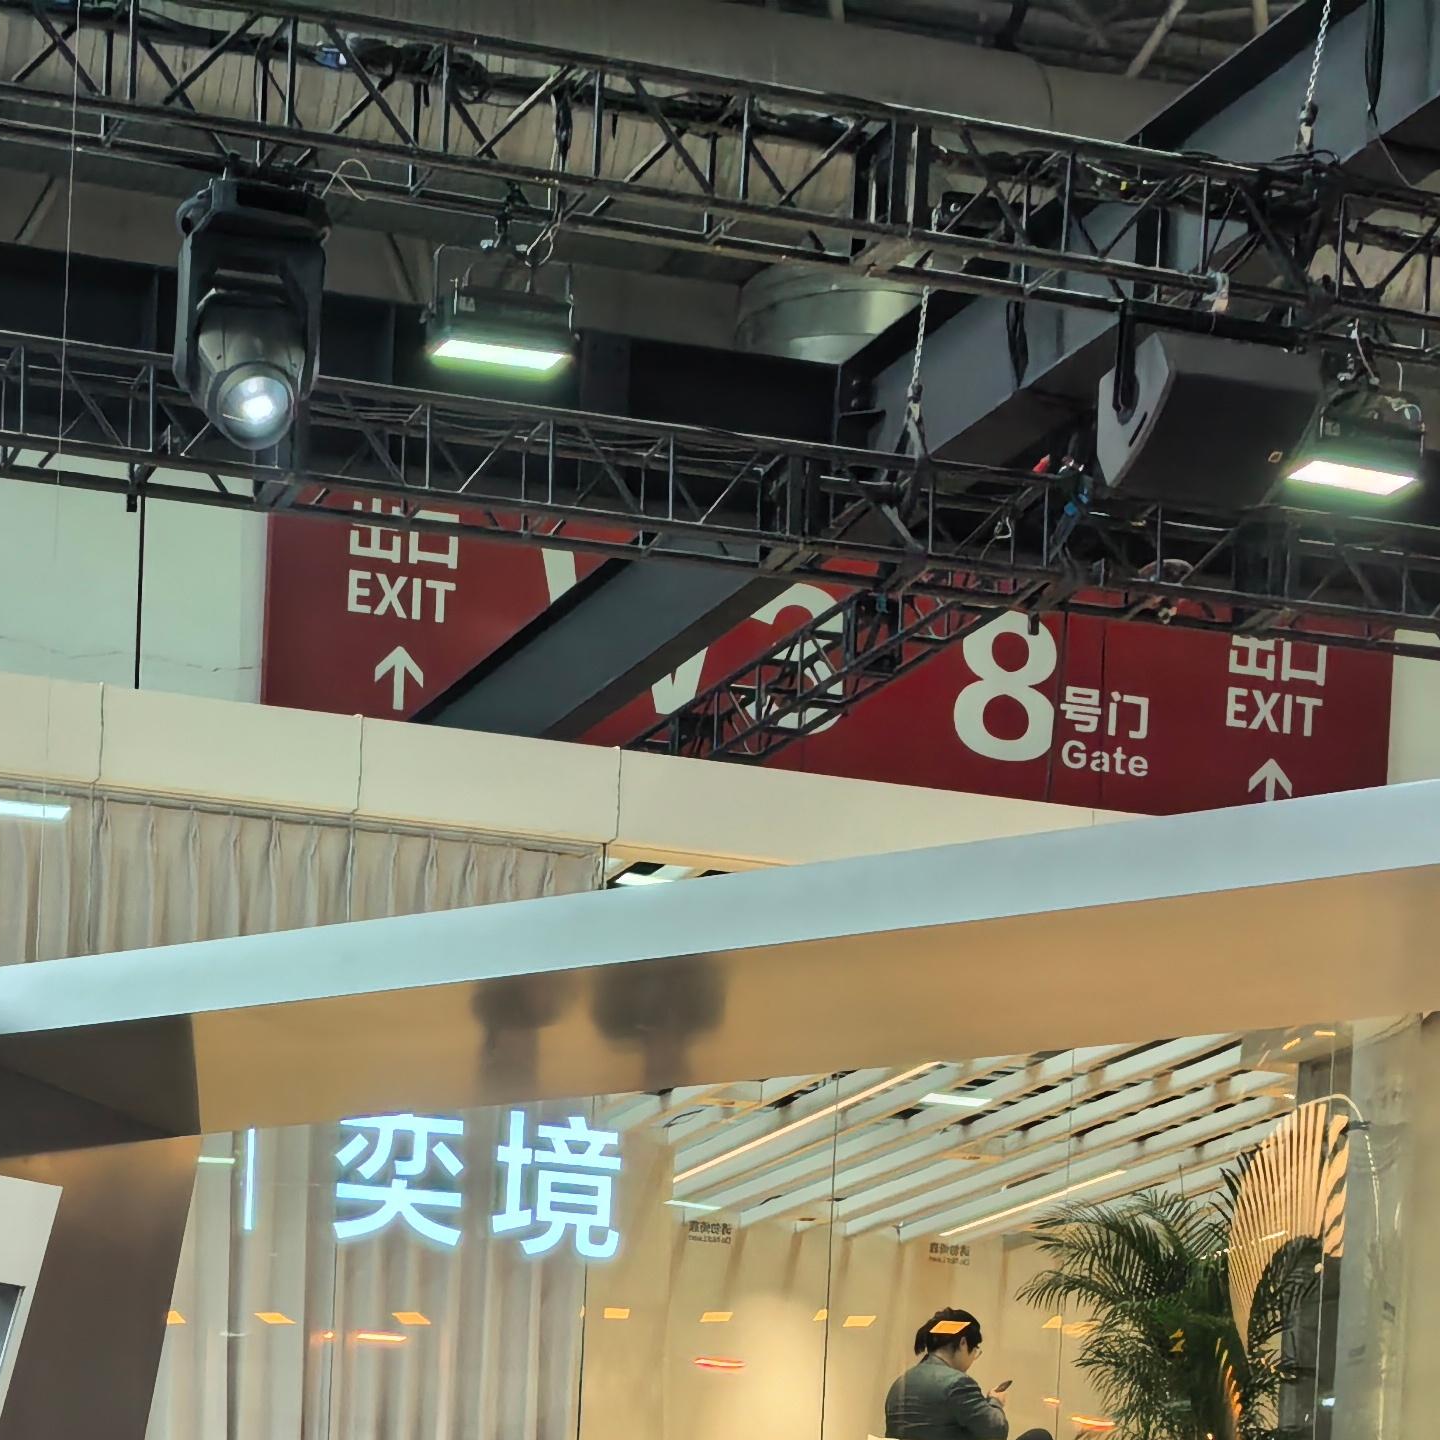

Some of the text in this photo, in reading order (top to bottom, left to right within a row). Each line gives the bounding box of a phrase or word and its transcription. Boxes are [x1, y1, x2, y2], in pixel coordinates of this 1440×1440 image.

[349, 498, 460, 570] 出口
[347, 568, 457, 624] EXIT
[1228, 634, 1328, 687] 出口
[1225, 686, 1324, 737] EXIT
[1061, 740, 1149, 777] Gate
[333, 1110, 622, 1259] 奕境
